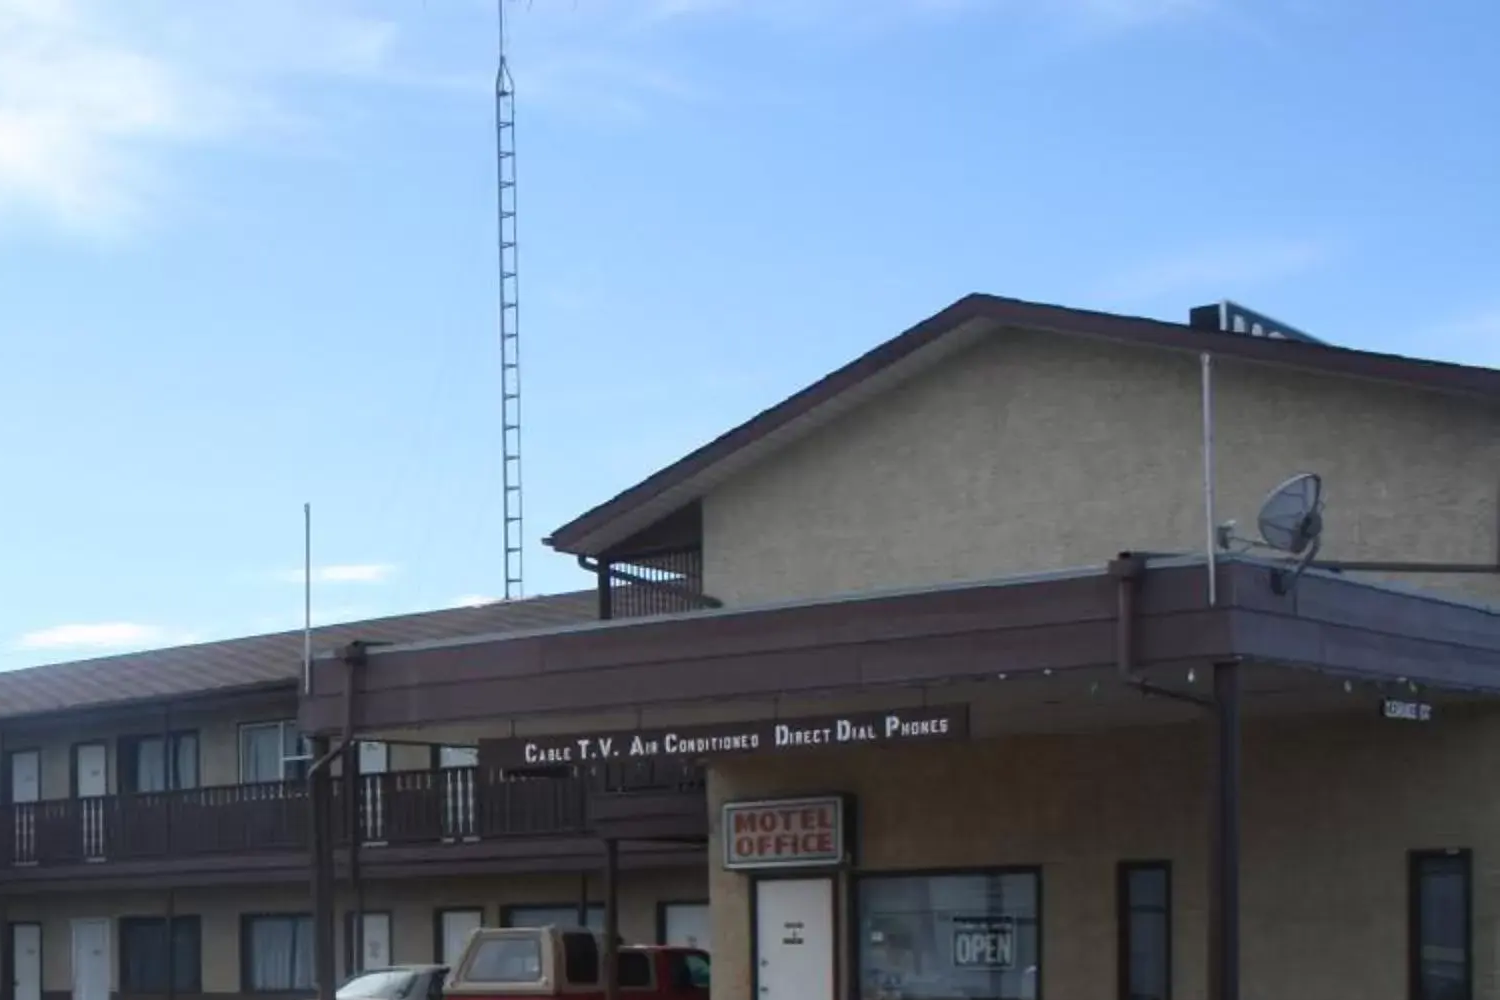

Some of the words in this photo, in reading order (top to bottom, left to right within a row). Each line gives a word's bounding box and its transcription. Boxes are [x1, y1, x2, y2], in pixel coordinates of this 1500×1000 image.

[577, 738, 619, 760] T.V.
[734, 808, 832, 834] MOTEL
[735, 832, 834, 857] OFFICE
[956, 933, 1012, 963] OPEN
